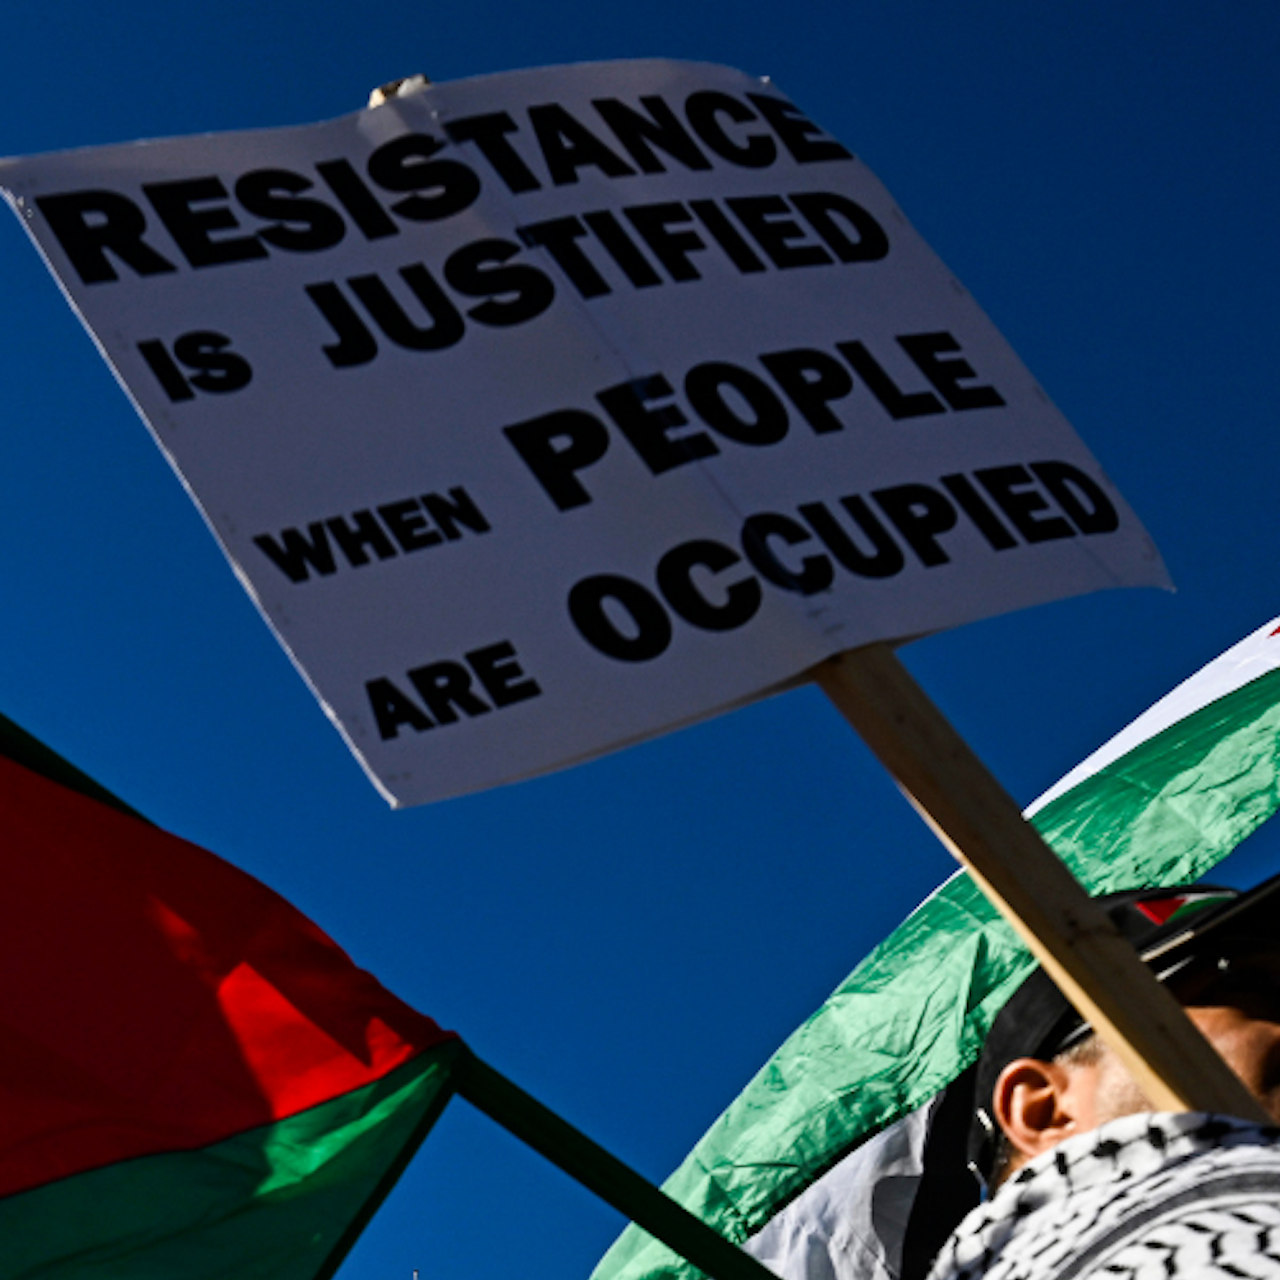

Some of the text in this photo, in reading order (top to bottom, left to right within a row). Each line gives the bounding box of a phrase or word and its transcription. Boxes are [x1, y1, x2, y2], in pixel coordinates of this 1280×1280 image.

[33, 88, 855, 287] RESISTANCE
[136, 190, 890, 404] IS JUSTIFIED
[252, 330, 1007, 585] WHEN PEOPLE
[365, 459, 1121, 741] ARE OCCUPIED
